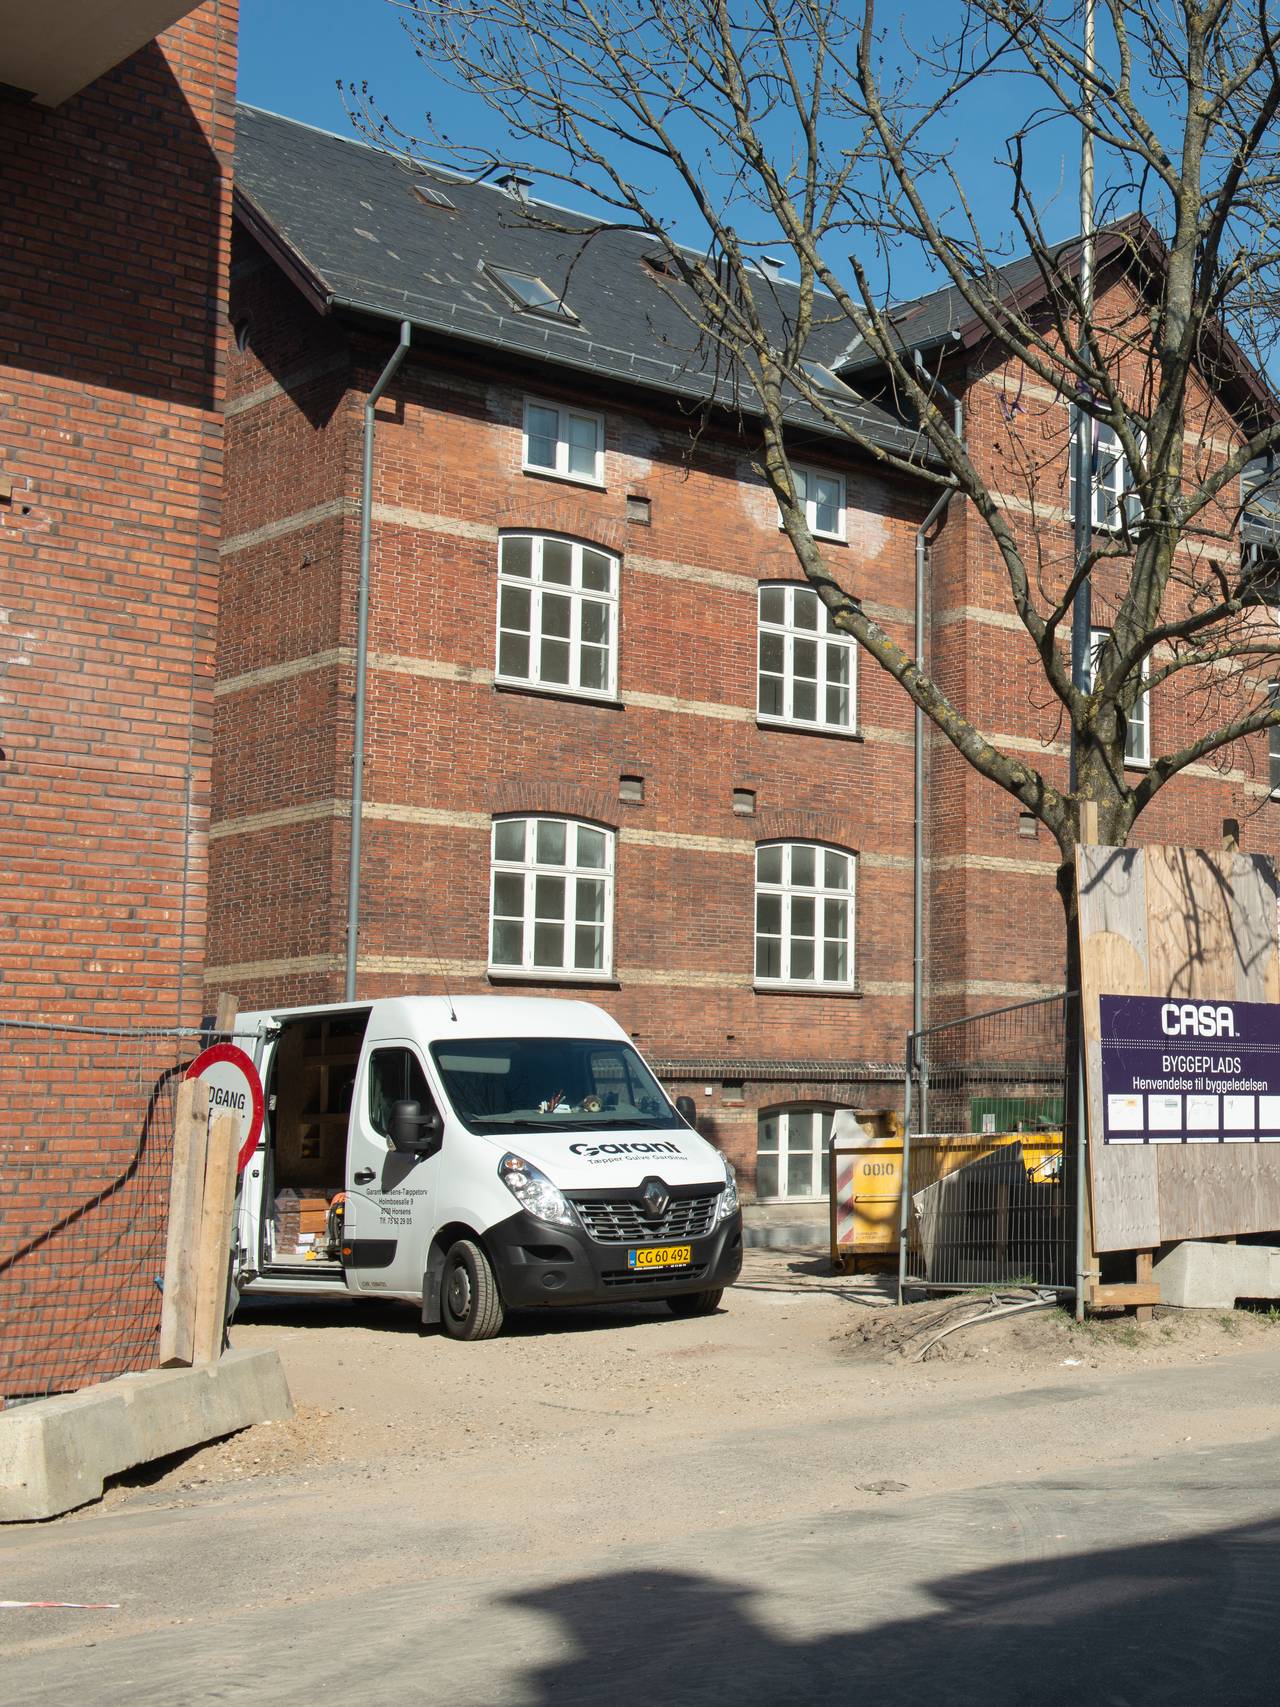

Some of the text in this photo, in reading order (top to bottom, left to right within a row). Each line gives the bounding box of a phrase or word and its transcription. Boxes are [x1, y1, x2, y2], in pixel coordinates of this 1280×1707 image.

[1161, 1003, 1234, 1037] CASA
[1162, 1055, 1241, 1073] BYGGEPLADS
[1133, 1076, 1268, 1093] Henvendelse til byggeledelsen
[208, 1086, 246, 1110] DGANG
[569, 1141, 682, 1156] Garant
[637, 1249, 689, 1264] CG 60 492
